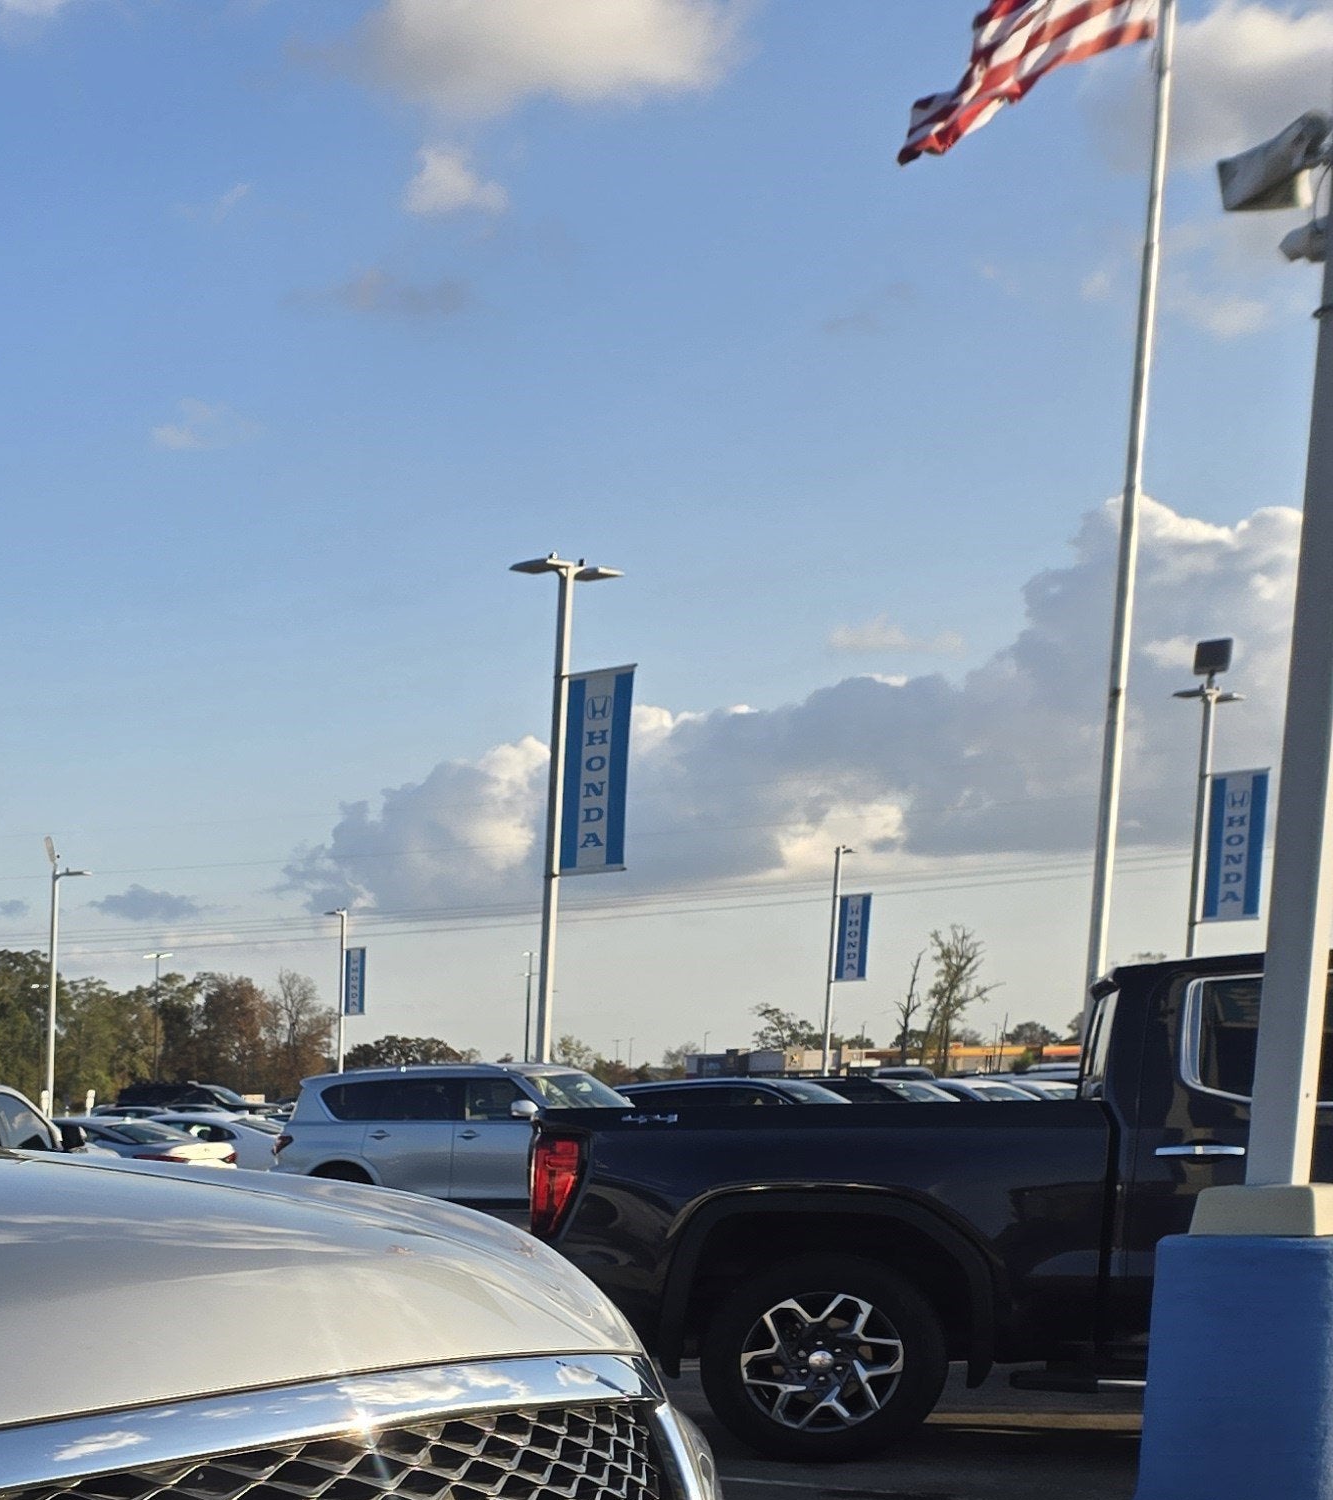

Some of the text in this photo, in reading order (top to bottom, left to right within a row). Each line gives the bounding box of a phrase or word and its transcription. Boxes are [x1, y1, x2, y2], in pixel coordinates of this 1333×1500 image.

[579, 729, 609, 849] HONDA
[1219, 814, 1247, 904] HONDA
[845, 919, 861, 972] HONDA
